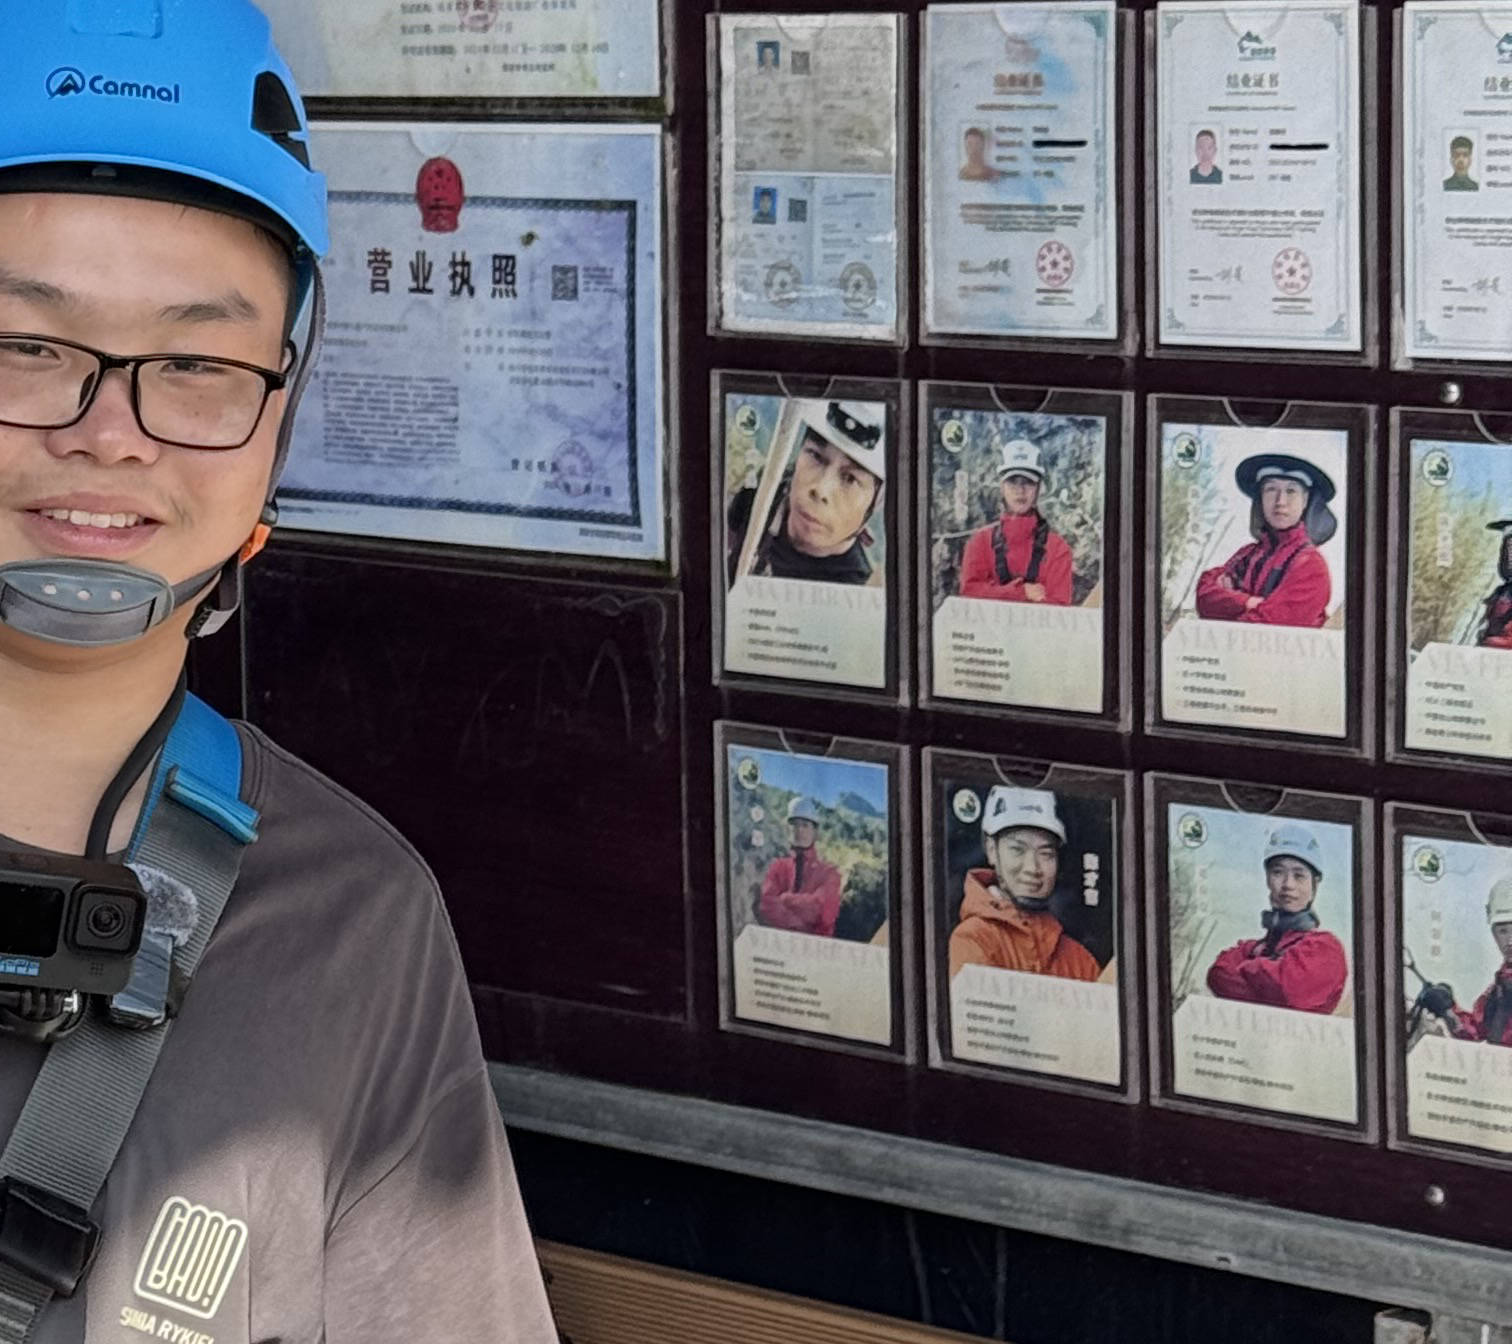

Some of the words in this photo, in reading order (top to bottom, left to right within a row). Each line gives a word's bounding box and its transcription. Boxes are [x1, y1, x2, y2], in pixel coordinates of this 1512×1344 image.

[89, 74, 180, 104] Camnal
[366, 247, 517, 299] 营业执照
